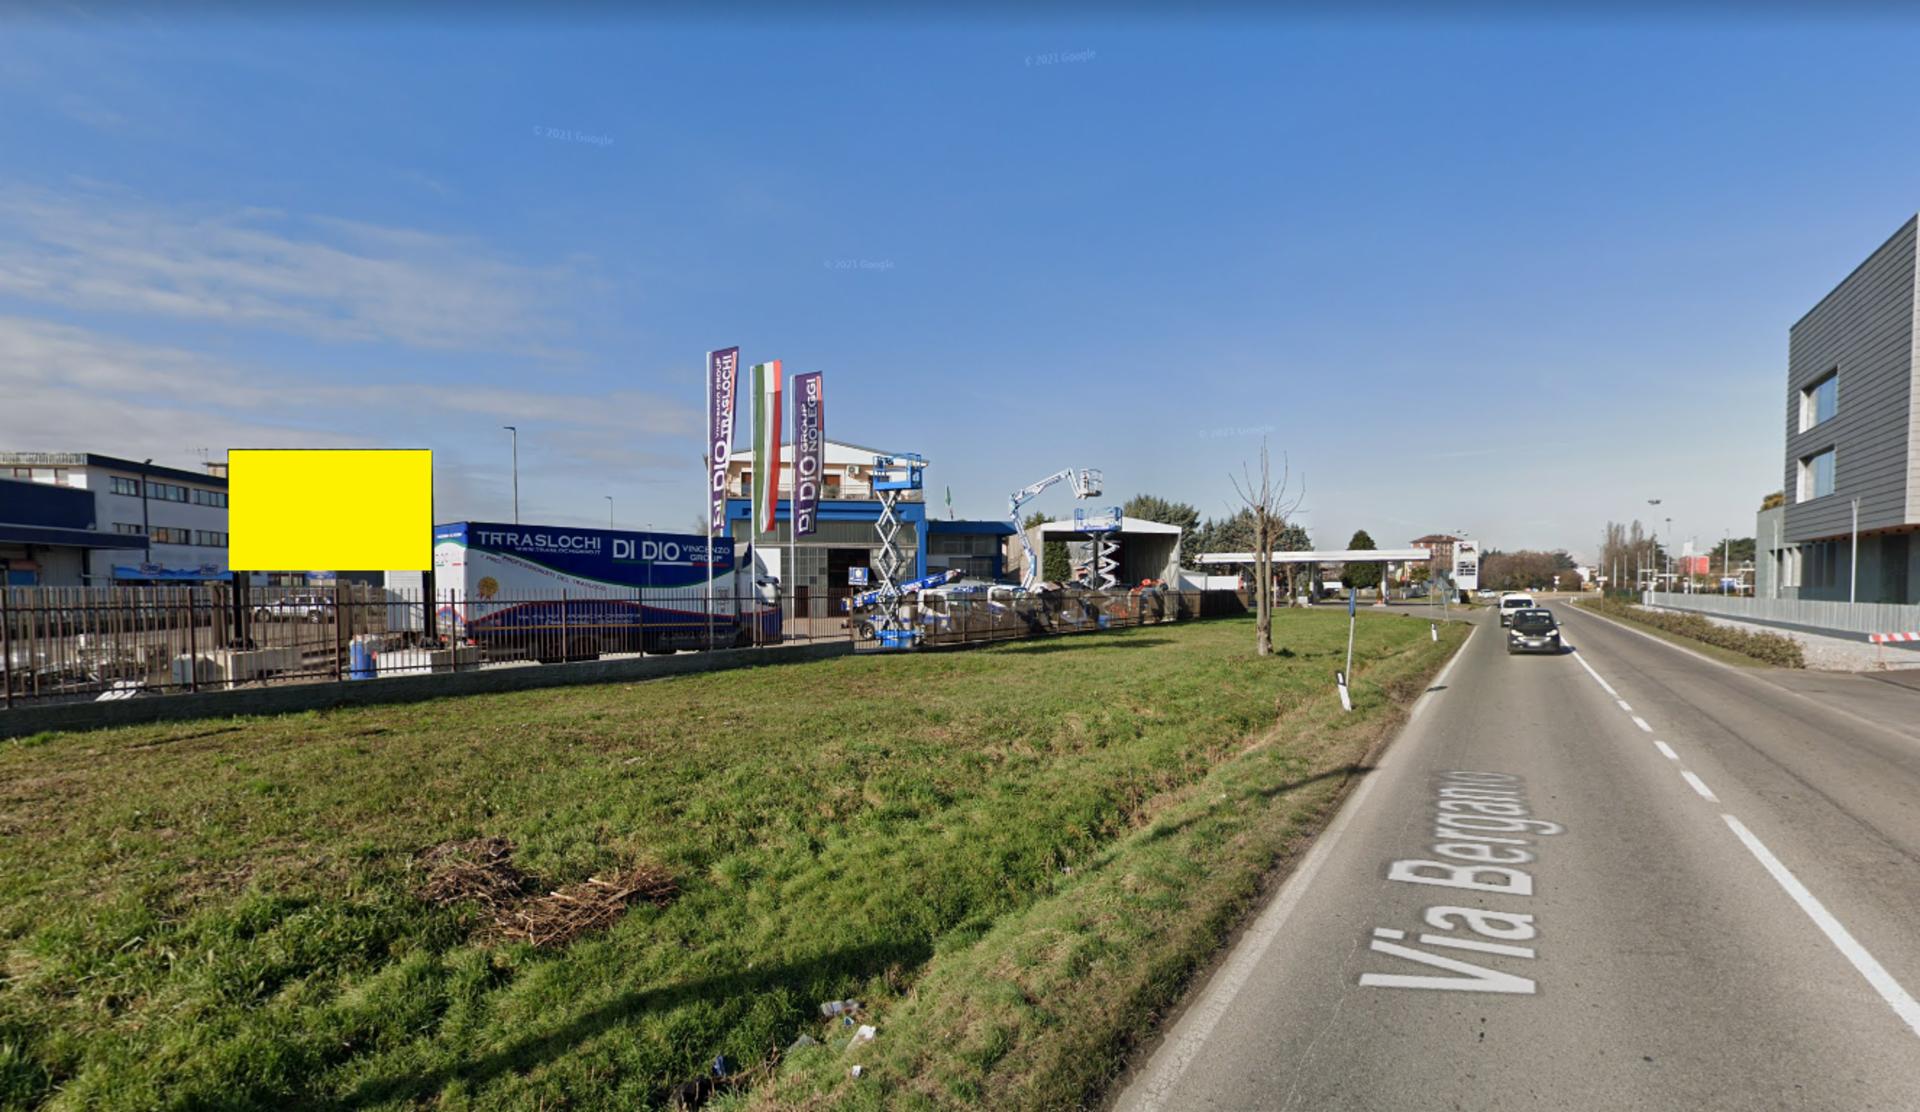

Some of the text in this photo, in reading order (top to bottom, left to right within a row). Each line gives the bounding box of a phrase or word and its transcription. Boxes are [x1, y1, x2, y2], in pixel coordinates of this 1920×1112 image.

[720, 354, 733, 438] TRASLOCHI
[800, 403, 808, 453] GROUP
[806, 377, 818, 452] NOLEGGI
[713, 440, 727, 492] DIO
[799, 455, 816, 533] DI DIO
[613, 539, 635, 559] DI
[642, 541, 680, 560] DIO
[1359, 770, 1566, 994] Via Bergamo
